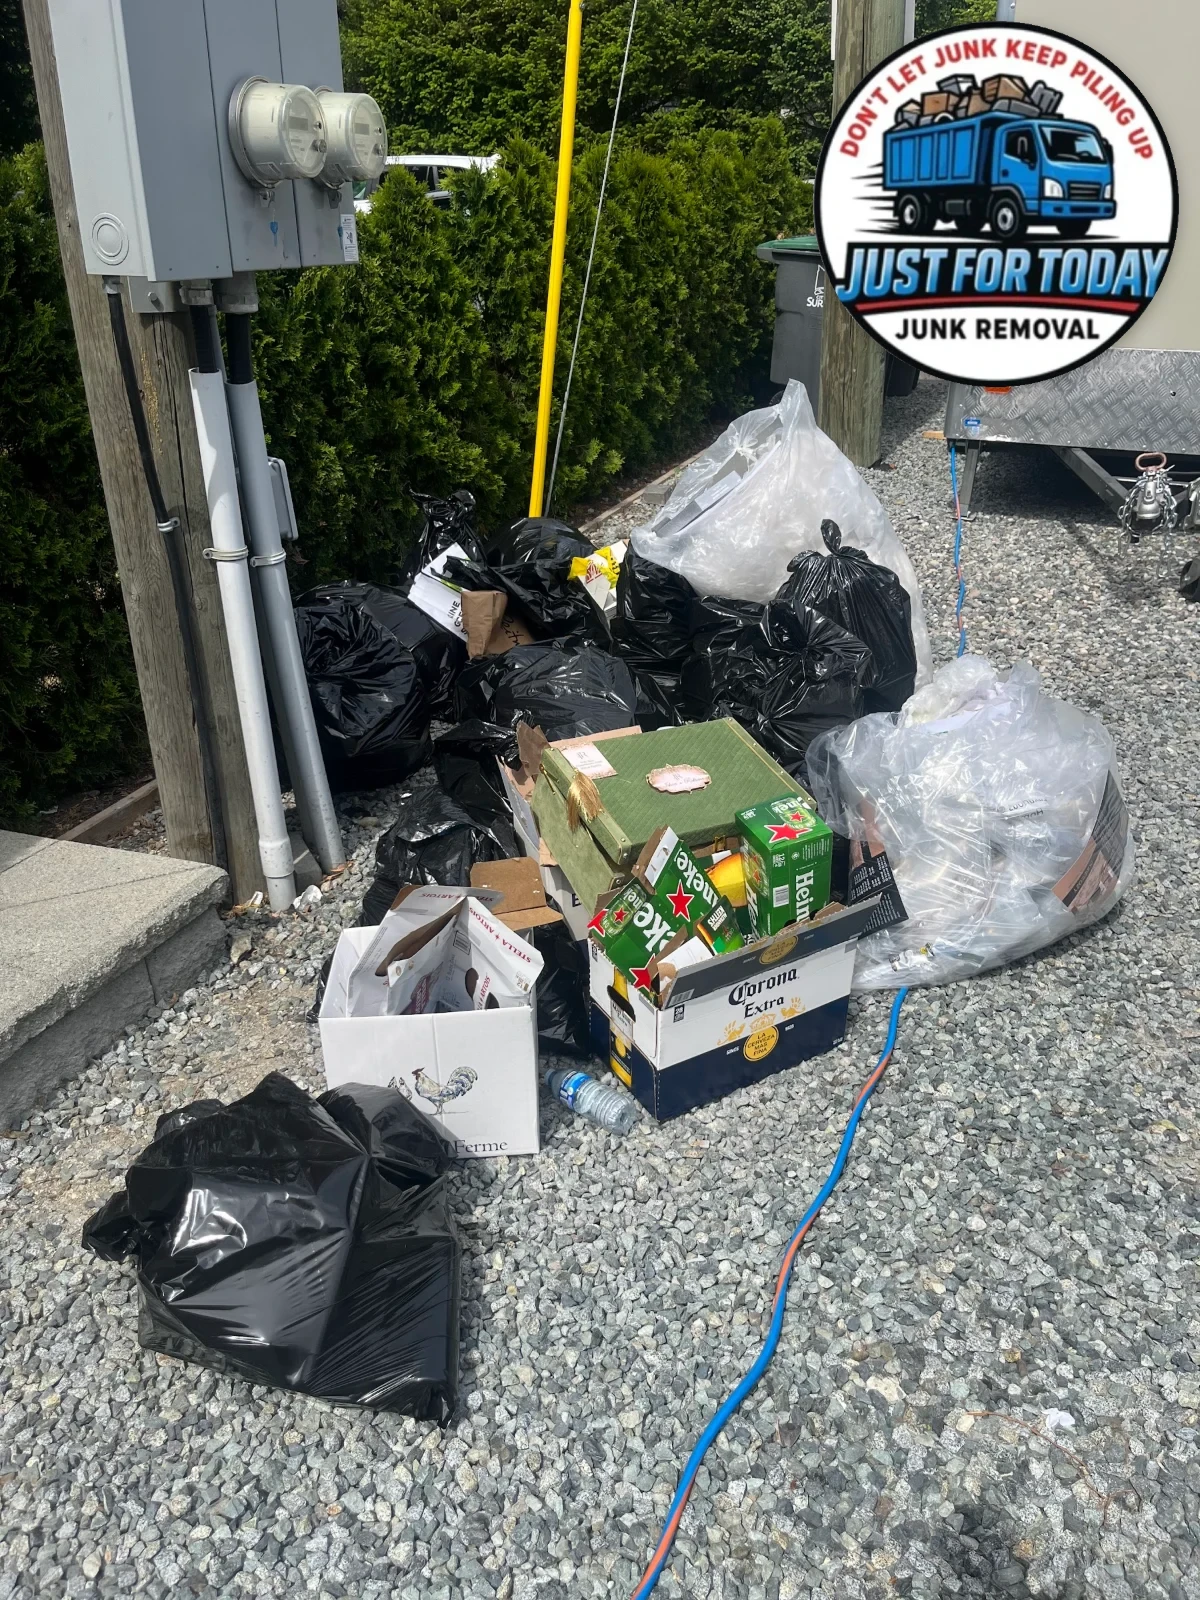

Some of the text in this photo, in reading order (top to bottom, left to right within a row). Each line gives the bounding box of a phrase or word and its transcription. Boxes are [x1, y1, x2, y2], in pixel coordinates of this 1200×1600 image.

[469, 906, 531, 963] STELLA ARTOIS
[728, 968, 797, 1006] Corona
[744, 996, 784, 1019] Extra
[747, 1034, 775, 1049] CERVEZA
[757, 1032, 766, 1040] LA
[454, 1139, 509, 1154] Ferme
